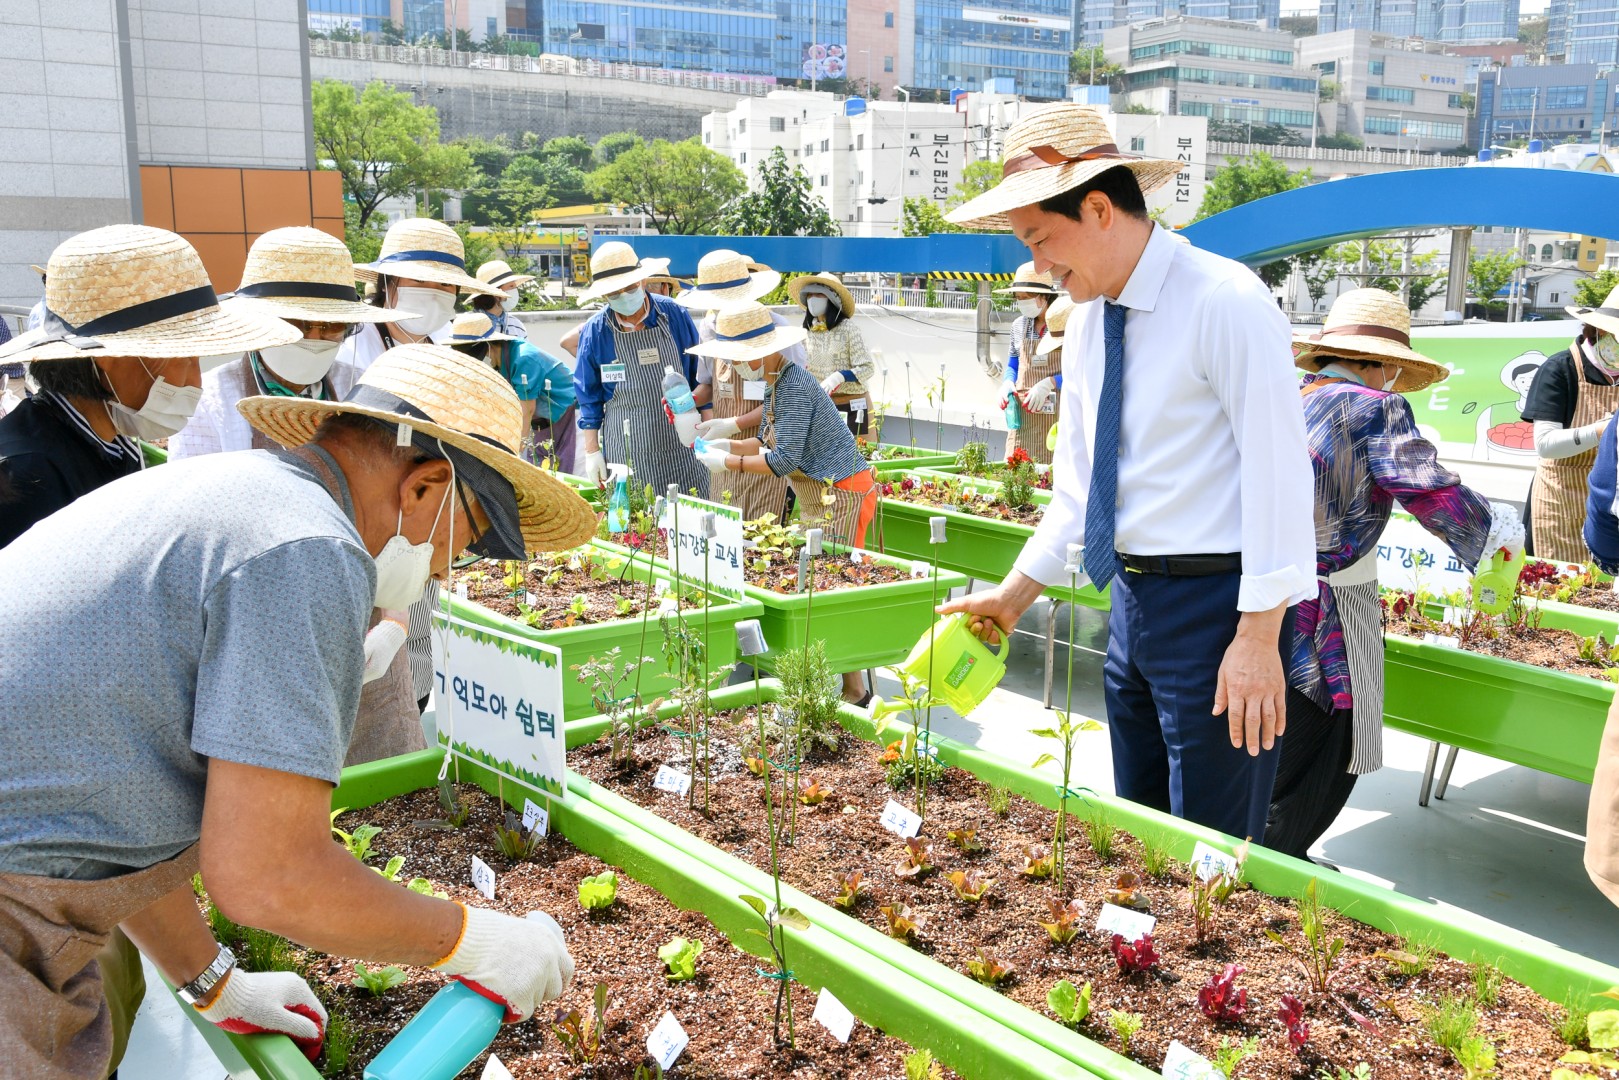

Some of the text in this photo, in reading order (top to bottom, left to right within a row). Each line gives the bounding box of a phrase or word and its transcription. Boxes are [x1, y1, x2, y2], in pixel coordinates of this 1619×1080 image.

[909, 146, 921, 158] A
[714, 542, 739, 569] 교실
[515, 698, 556, 739] 쉼터
[657, 771, 686, 793] 토마토
[887, 812, 908, 835] 고추
